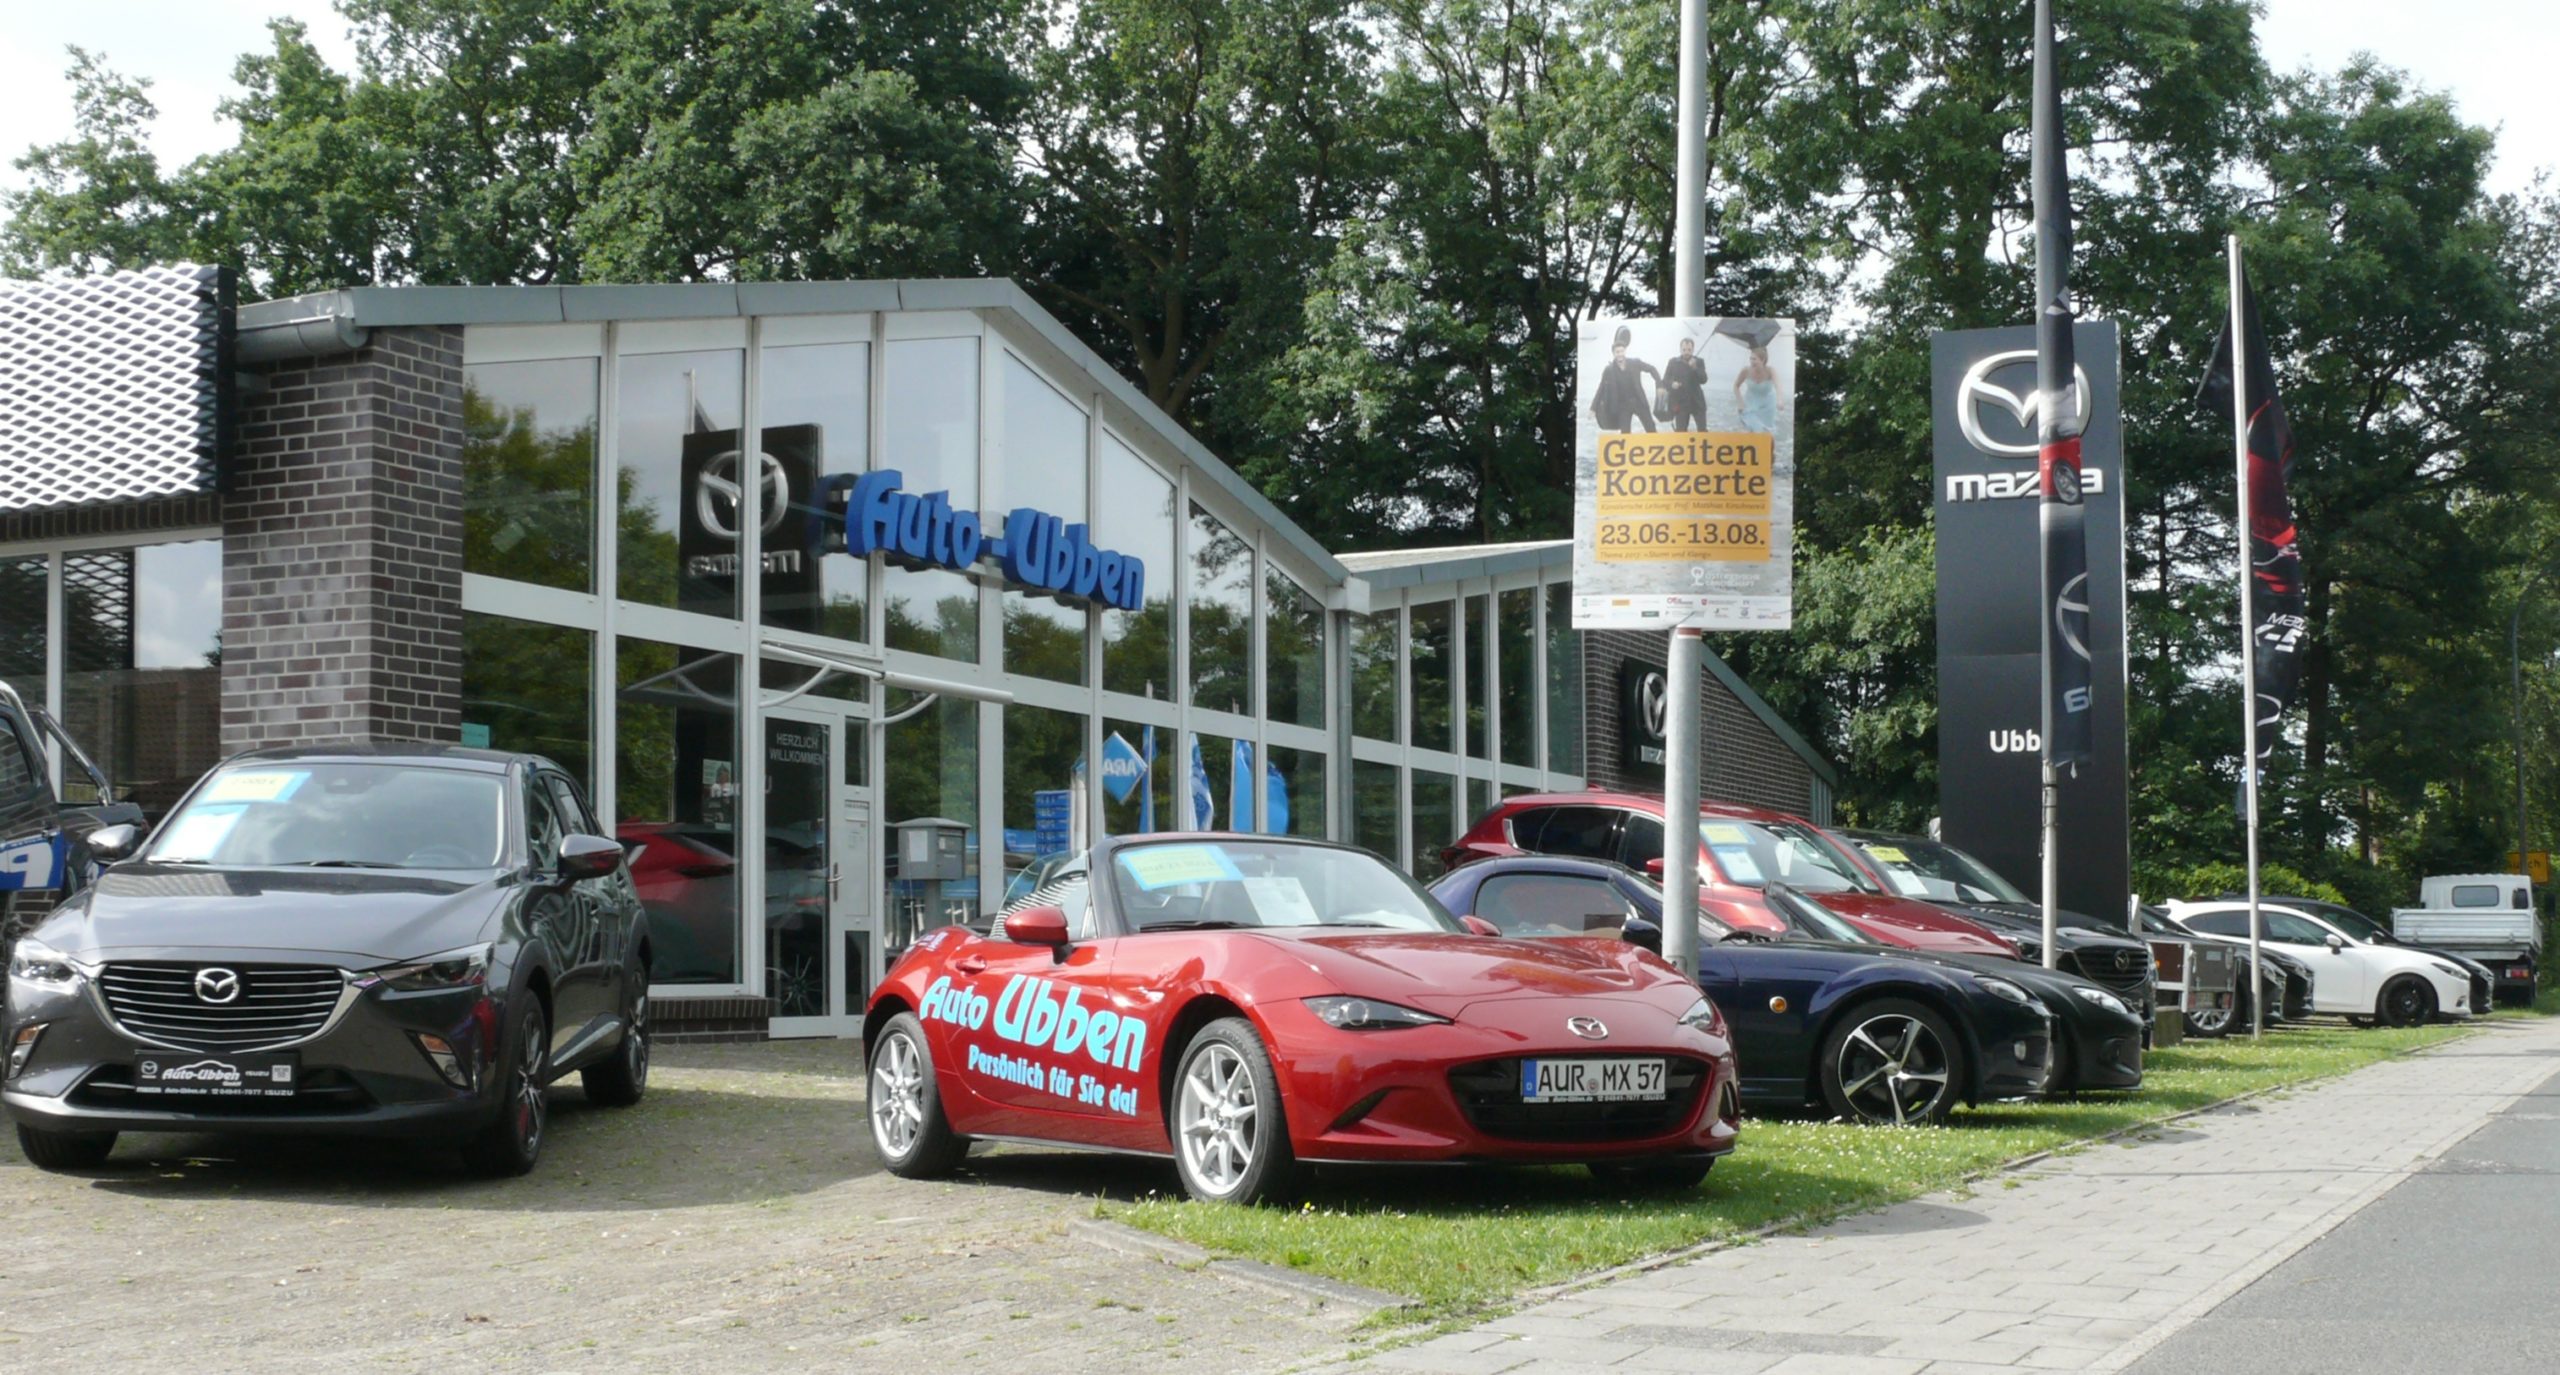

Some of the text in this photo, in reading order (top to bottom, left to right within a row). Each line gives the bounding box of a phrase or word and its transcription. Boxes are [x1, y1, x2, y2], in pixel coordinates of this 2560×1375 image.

[1603, 437, 1759, 467] Gezeiten
[1602, 469, 1767, 497] Konzerte
[1946, 468, 2104, 502] maza
[846, 469, 1145, 611] Auto-Ubben
[1600, 522, 1766, 546] 23.06.-13.08.
[776, 733, 819, 749] HERZLICH
[1990, 729, 2042, 753] Ubb
[769, 747, 824, 766] WILLKOMMEN
[919, 974, 1147, 1073] Auto Ubben
[161, 1067, 241, 1081] Auto-Ubben
[968, 1044, 1138, 1117] Persönlich für Sie da!
[1538, 1063, 1664, 1092] AUR MX 57
